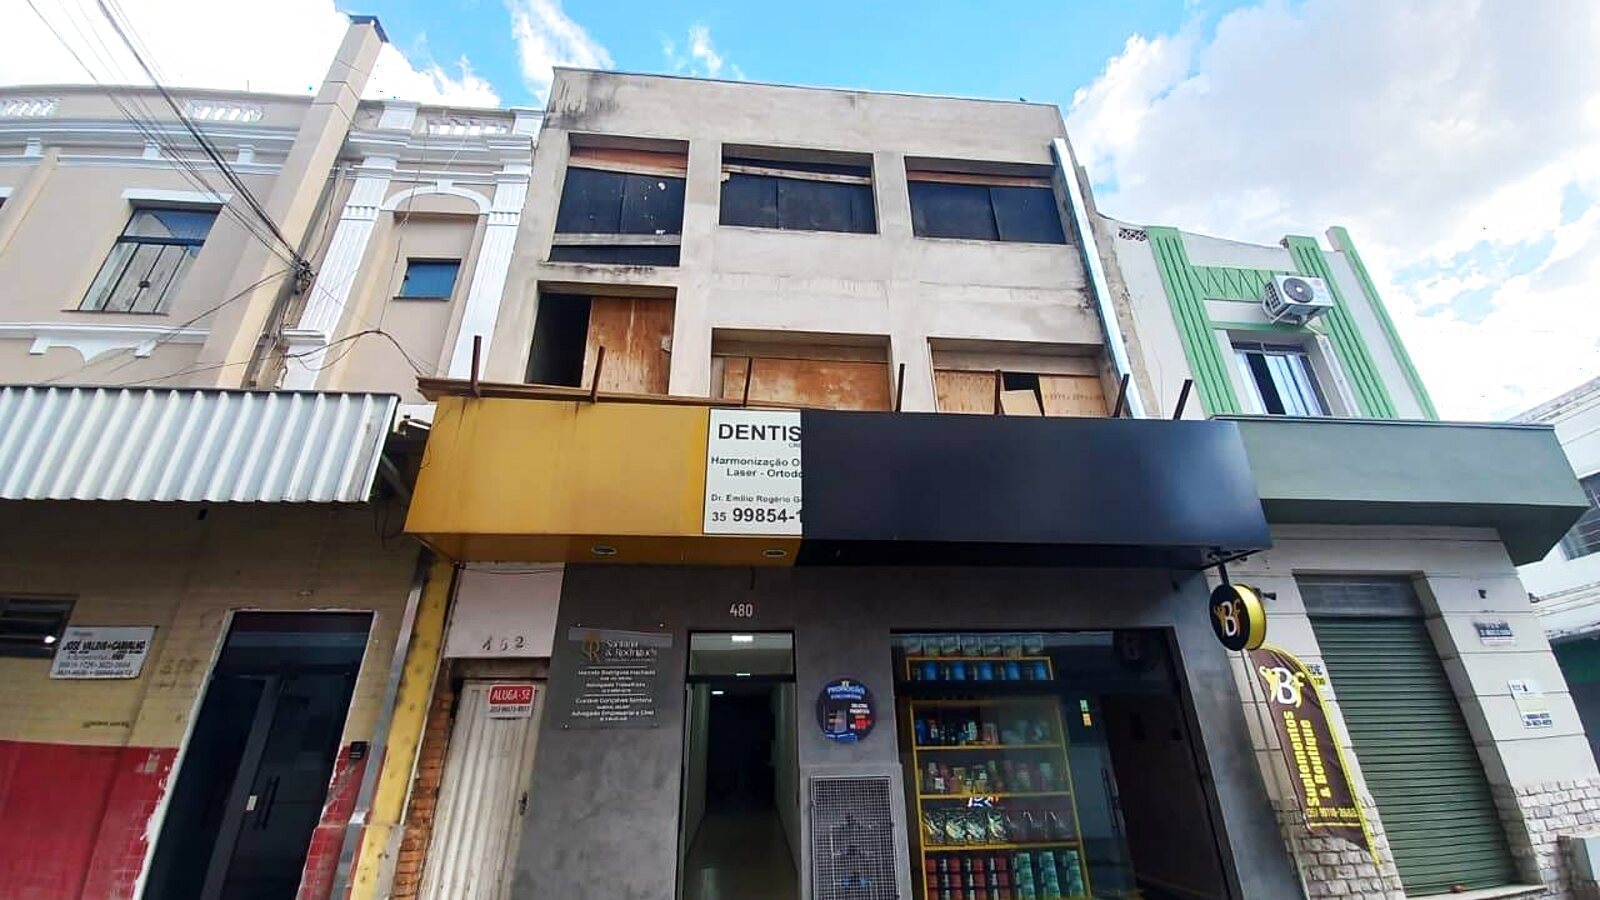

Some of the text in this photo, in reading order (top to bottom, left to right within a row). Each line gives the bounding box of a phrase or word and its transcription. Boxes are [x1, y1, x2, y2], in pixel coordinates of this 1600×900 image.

[718, 424, 801, 442] DENTIS
[711, 457, 788, 467] Harmonização
[727, 468, 757, 477] Laser
[712, 512, 727, 522] 35
[729, 603, 753, 617] 480
[1283, 710, 1320, 807] Suplementos
[1300, 719, 1327, 784] Boutique
